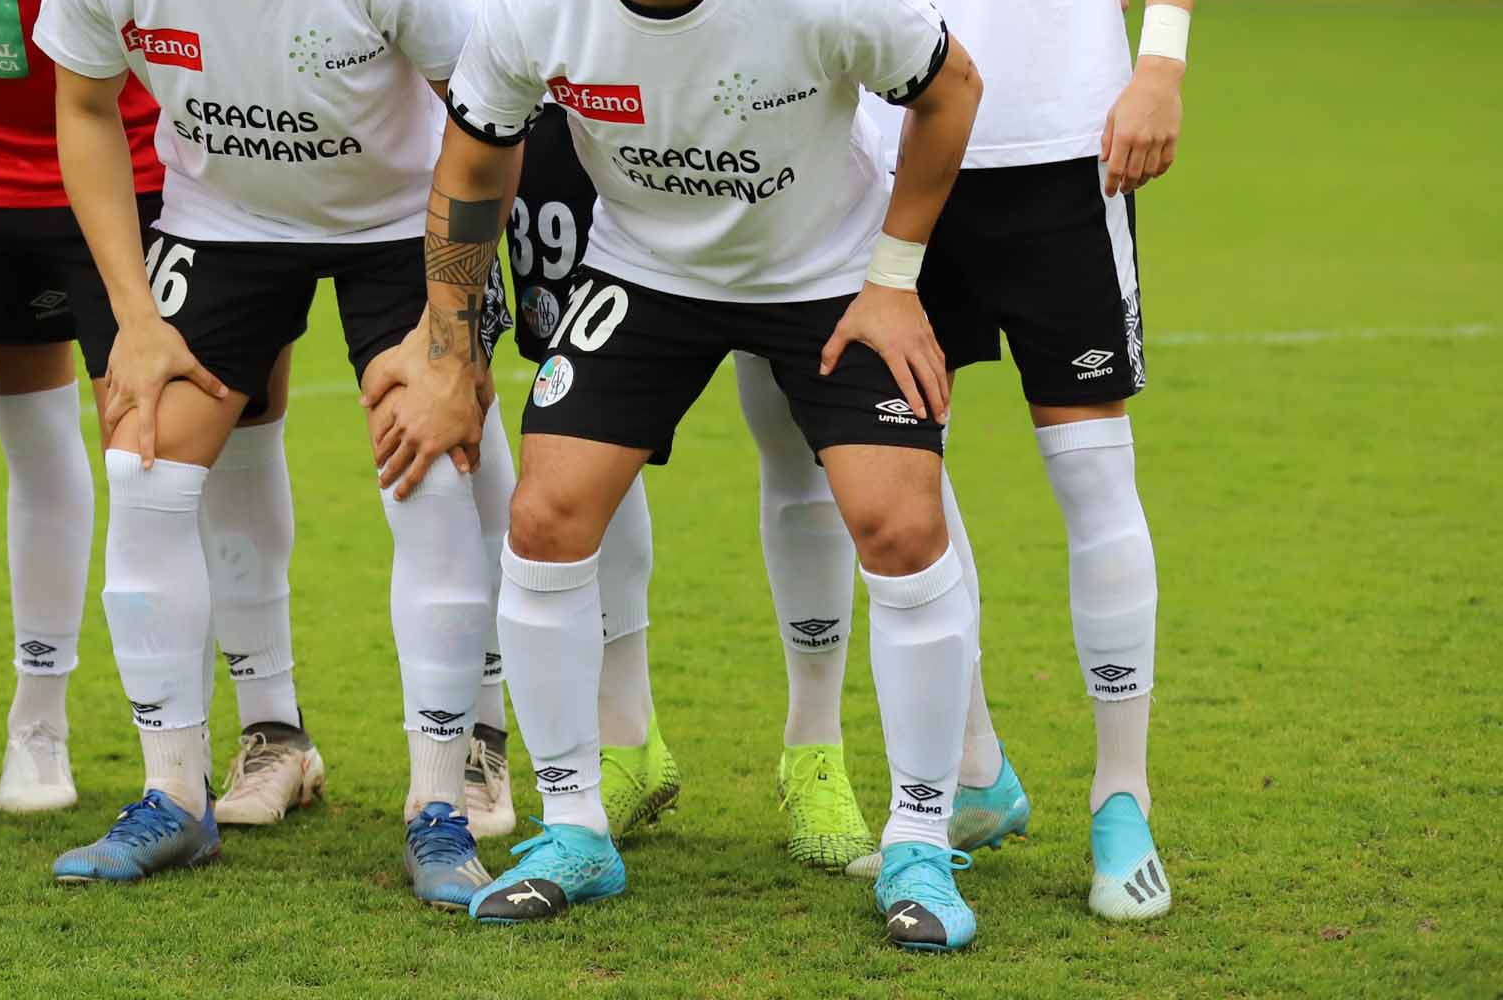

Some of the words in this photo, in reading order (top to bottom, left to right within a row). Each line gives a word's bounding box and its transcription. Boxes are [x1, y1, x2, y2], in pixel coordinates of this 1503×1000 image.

[325, 46, 385, 70] CHARRA
[752, 87, 818, 111] CHARRA
[619, 146, 761, 174] GRACIAS
[613, 157, 795, 204] ALAMANCA
[511, 196, 577, 280] 39
[145, 236, 196, 318] 16
[548, 278, 629, 352] 10
[1077, 367, 1113, 380] umbro
[878, 414, 918, 425] umbro
[793, 634, 839, 648] umbro
[230, 667, 255, 677] bro
[1095, 683, 1137, 693] umbro
[136, 714, 162, 727] bro
[421, 725, 464, 736] umbro
[898, 801, 943, 815] umbro
